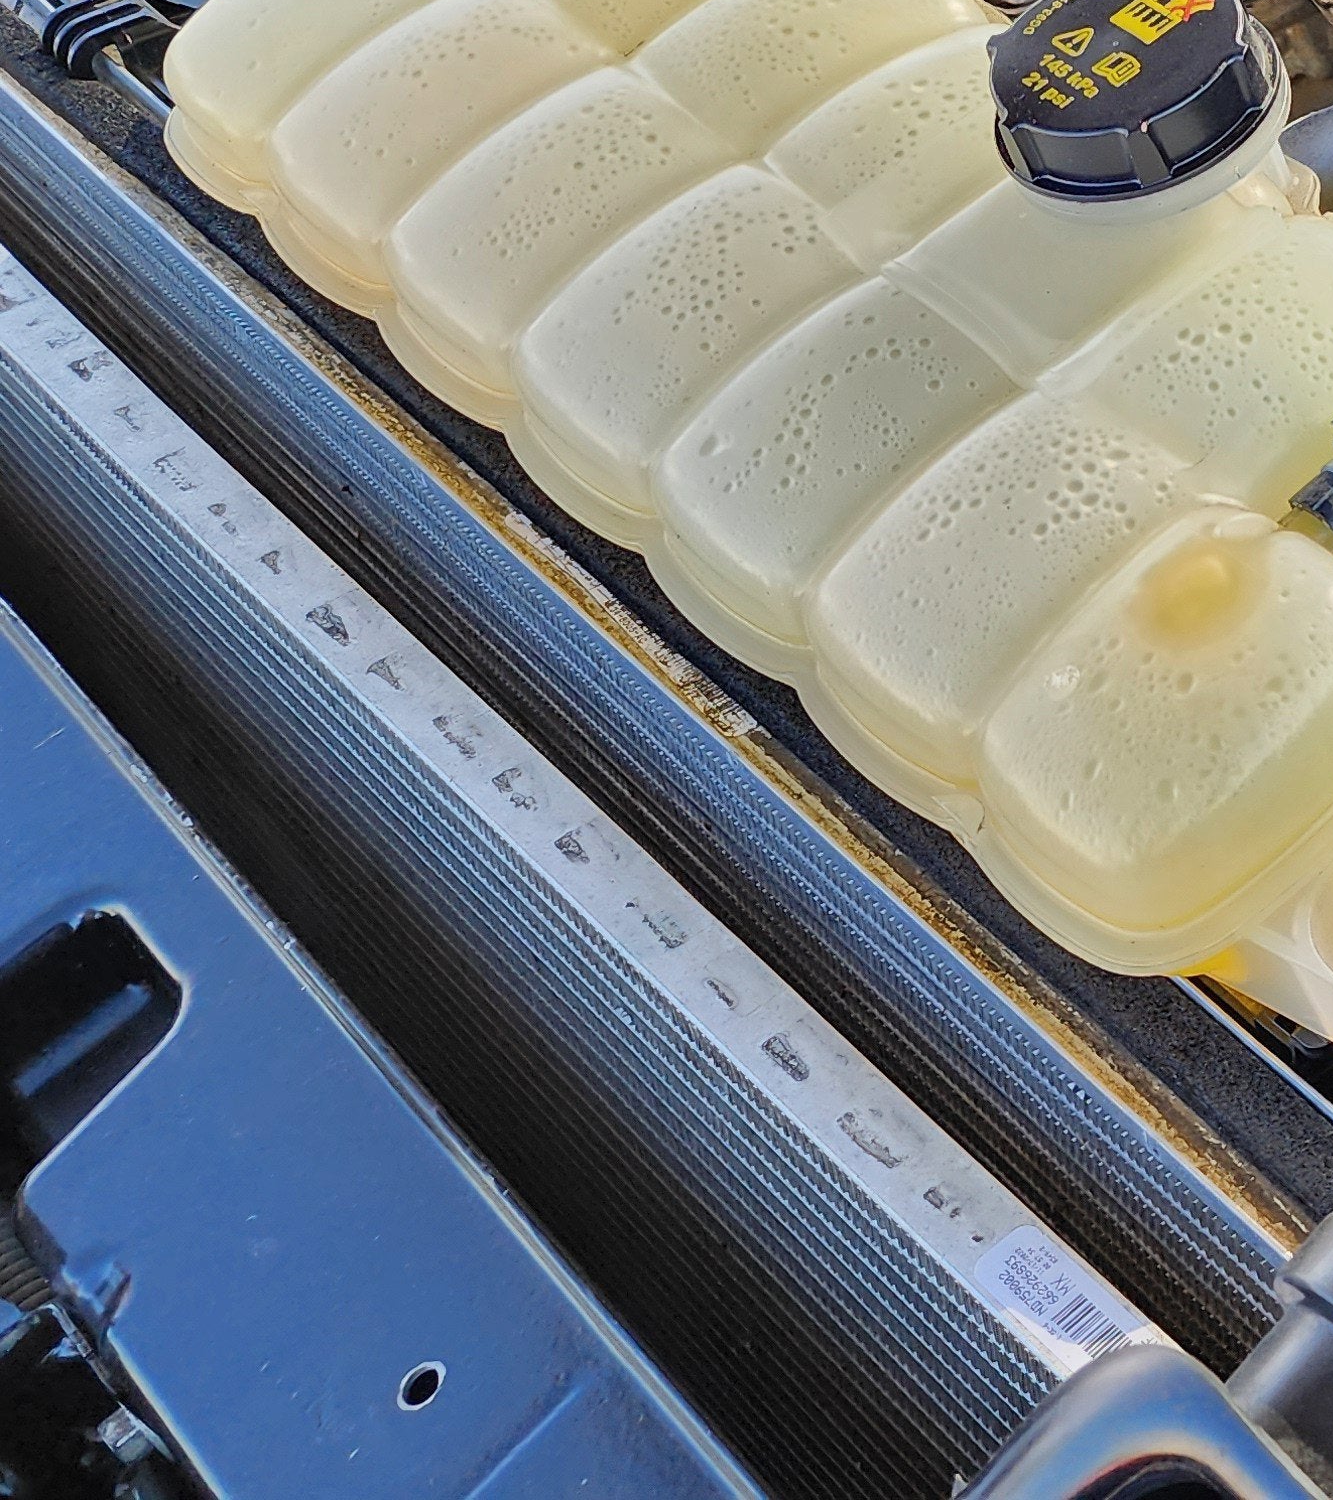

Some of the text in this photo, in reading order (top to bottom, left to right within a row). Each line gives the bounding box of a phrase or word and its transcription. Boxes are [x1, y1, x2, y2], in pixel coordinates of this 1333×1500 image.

[1021, 71, 1075, 110] 21 psi
[1039, 53, 1100, 99] 145 kPa
[998, 1269, 1048, 1316] ND759002
[1049, 1272, 1077, 1296] MX
